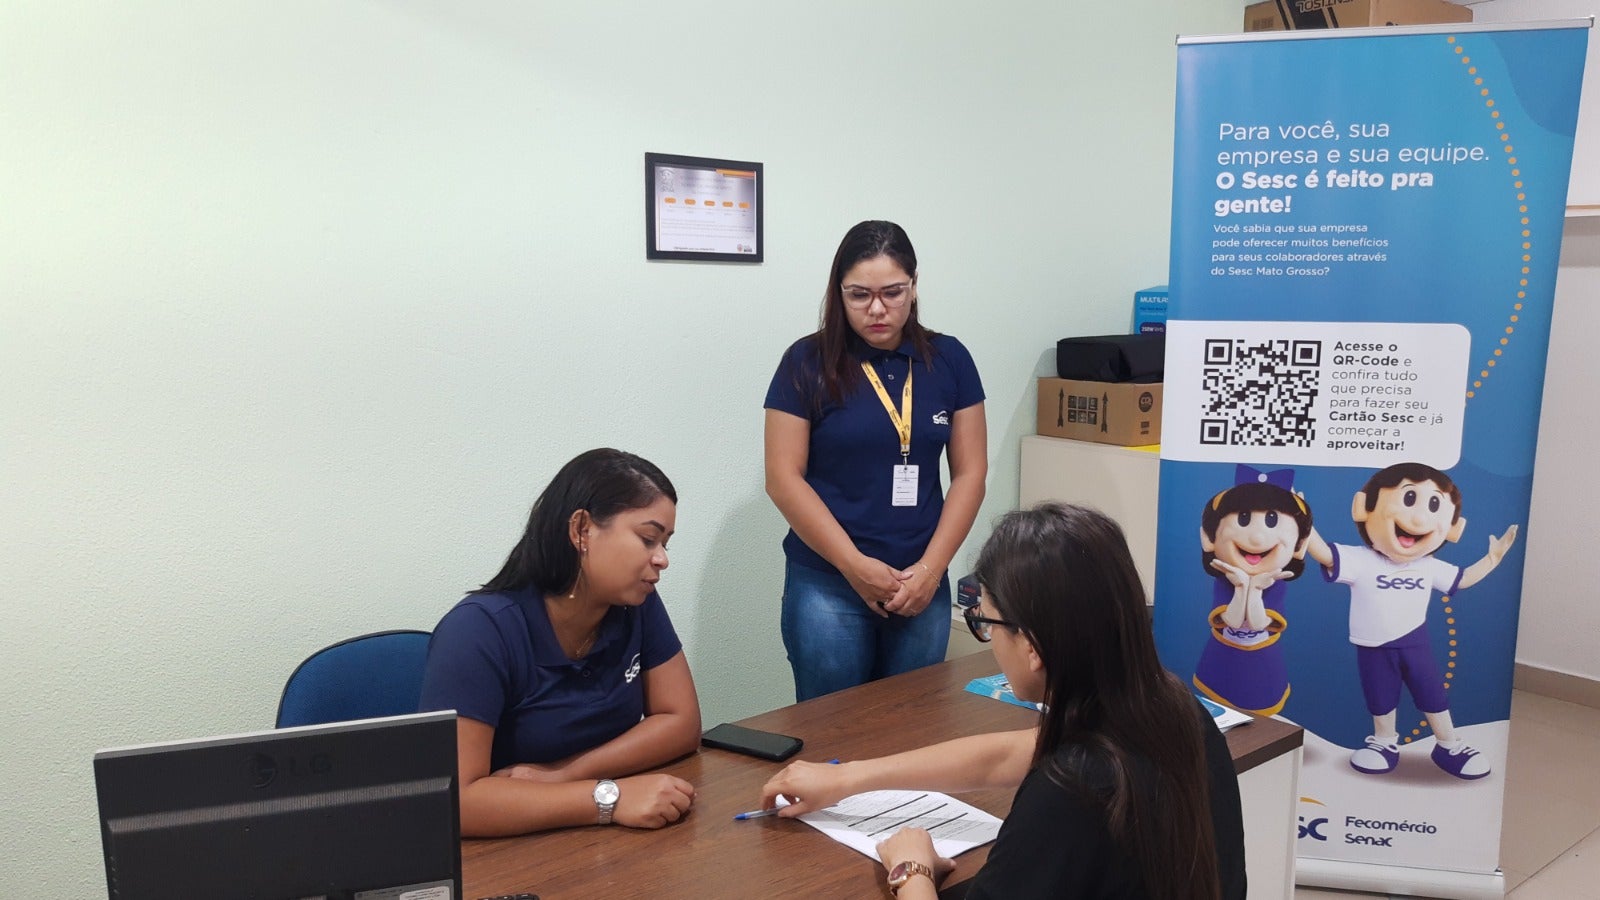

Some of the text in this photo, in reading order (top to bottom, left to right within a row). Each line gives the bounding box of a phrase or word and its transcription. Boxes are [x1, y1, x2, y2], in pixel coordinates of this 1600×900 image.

[1220, 119, 1389, 140] Para você, sua
[1218, 142, 1488, 167] empresa e sua equipe.
[1216, 168, 1433, 190] O Sesc é feito pra
[1215, 195, 1291, 216] gente!
[1214, 223, 1239, 233] Você
[1243, 223, 1271, 232] sabia
[1274, 225, 1295, 234] que
[1320, 224, 1367, 235] empresa
[1212, 237, 1388, 248] pode oferecer muitos benefícios
[1212, 251, 1386, 264] para seus colaboradores através
[1211, 266, 1330, 275] do Sesc Mato Grosso?
[1334, 340, 1397, 351] Acesse o
[1333, 354, 1412, 366] QR-Code e
[1332, 368, 1417, 381] confira tudo
[1331, 384, 1411, 397] que precisa
[1330, 396, 1428, 410] para fazer seu
[1329, 410, 1443, 425] Cartão Sesc e já
[1328, 426, 1400, 437] começar a
[1327, 439, 1404, 450] aproveitar!
[1376, 574, 1424, 590] Sesc
[1345, 815, 1437, 836] Fecomércio
[1345, 832, 1392, 847] Senac
